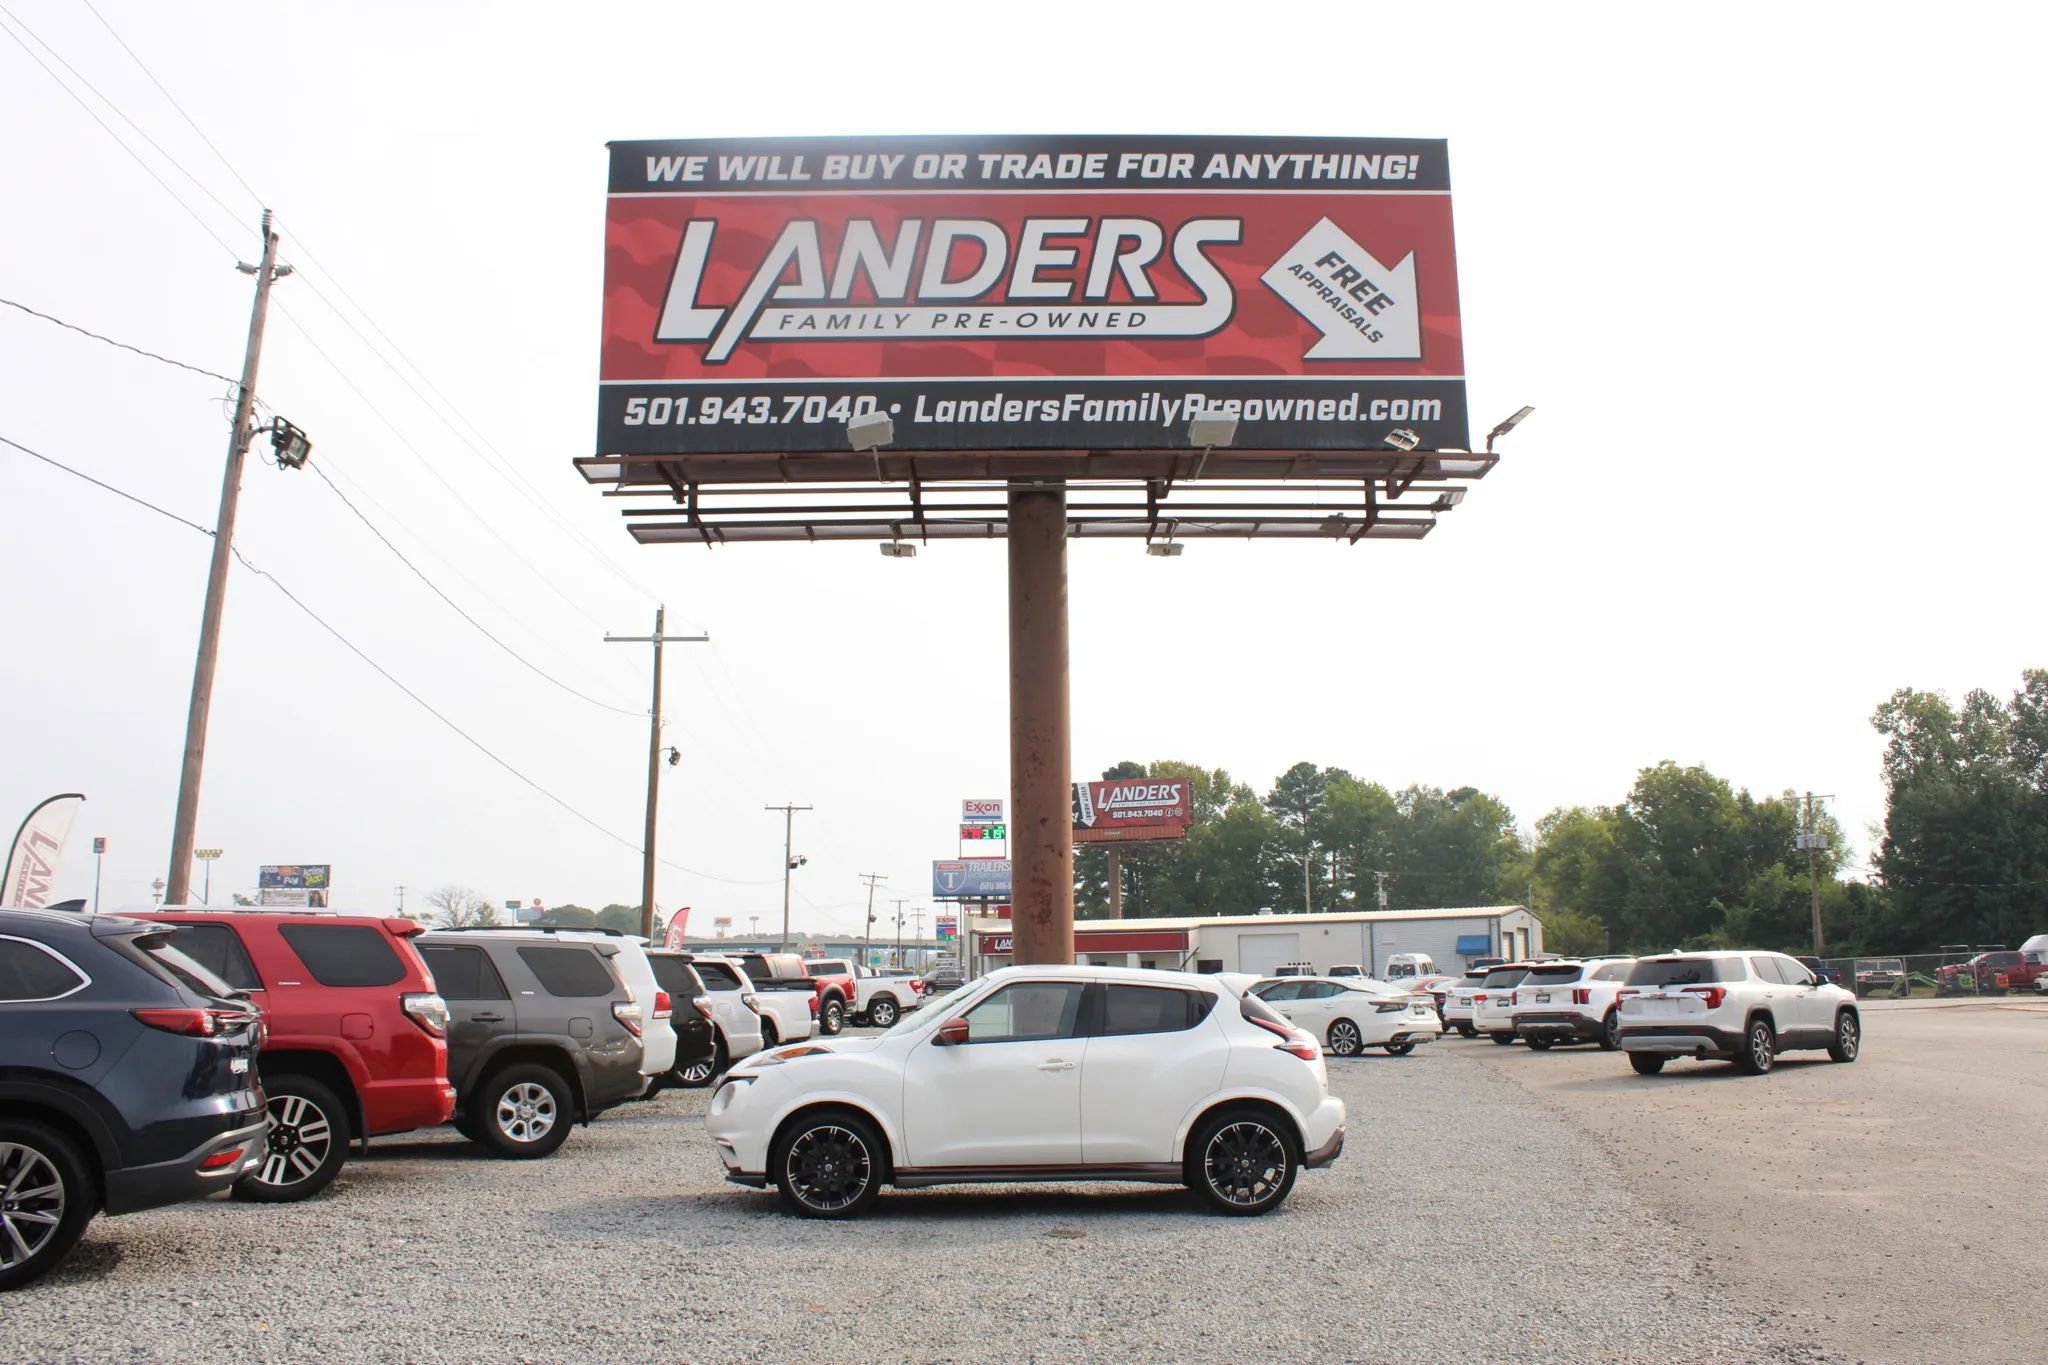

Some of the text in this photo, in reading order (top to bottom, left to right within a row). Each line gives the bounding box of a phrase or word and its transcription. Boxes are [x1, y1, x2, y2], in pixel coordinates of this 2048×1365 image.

[646, 153, 1420, 182] WE WILL BUY OR TRADE FOR ANYTHING!
[655, 217, 1241, 362] LANDERS
[1314, 250, 1395, 317] FREE
[1287, 263, 1384, 344] APPRAISALS
[780, 312, 1147, 330] FAMILY PRE-OWNED
[966, 801, 1000, 815] Exxon
[1097, 784, 1181, 812] LANDERS
[943, 872, 958, 889] T
